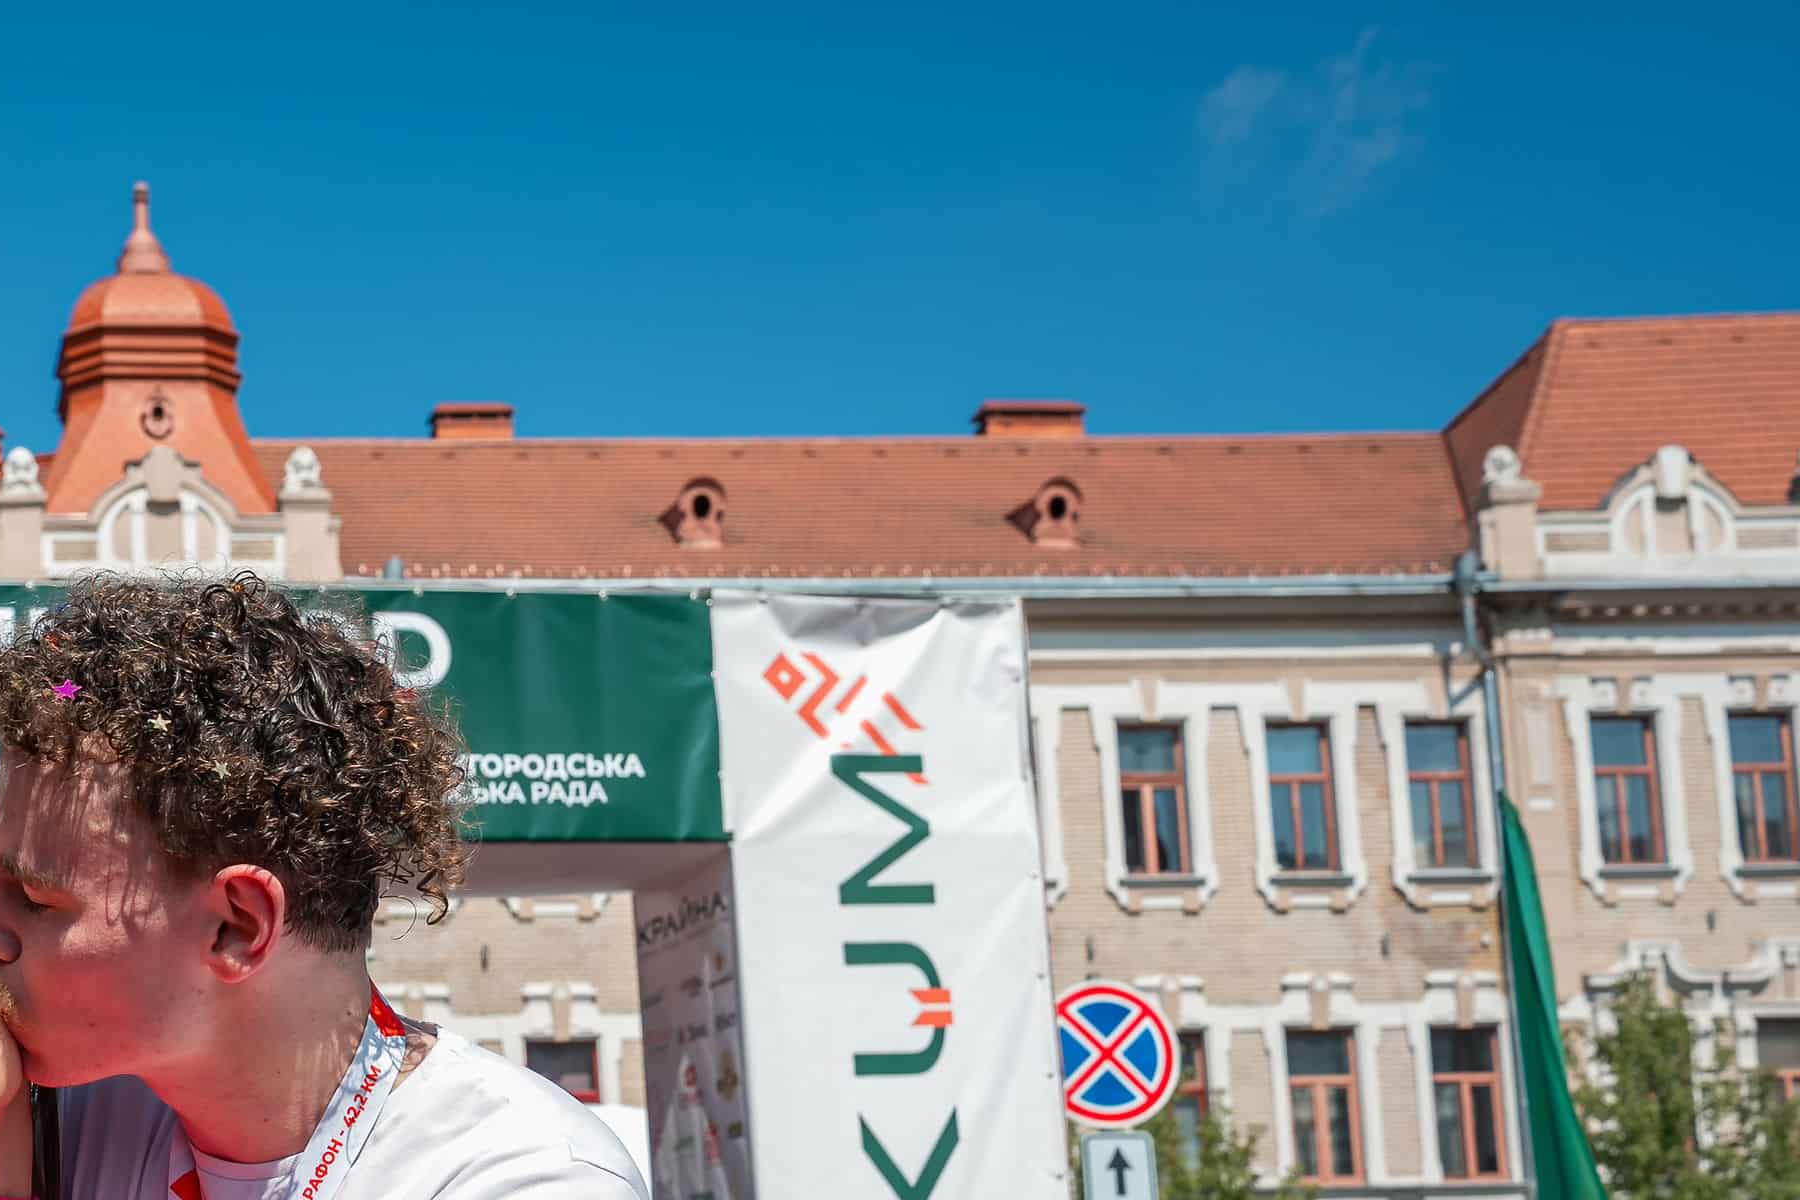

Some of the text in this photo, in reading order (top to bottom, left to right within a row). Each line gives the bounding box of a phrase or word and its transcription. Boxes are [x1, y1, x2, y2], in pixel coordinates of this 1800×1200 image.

[456, 752, 646, 782] ГОРОДСЬКА
[531, 781, 608, 807] РАДА
[343, 1093, 369, 1129] 42,2
[360, 1065, 382, 1093] КМ
